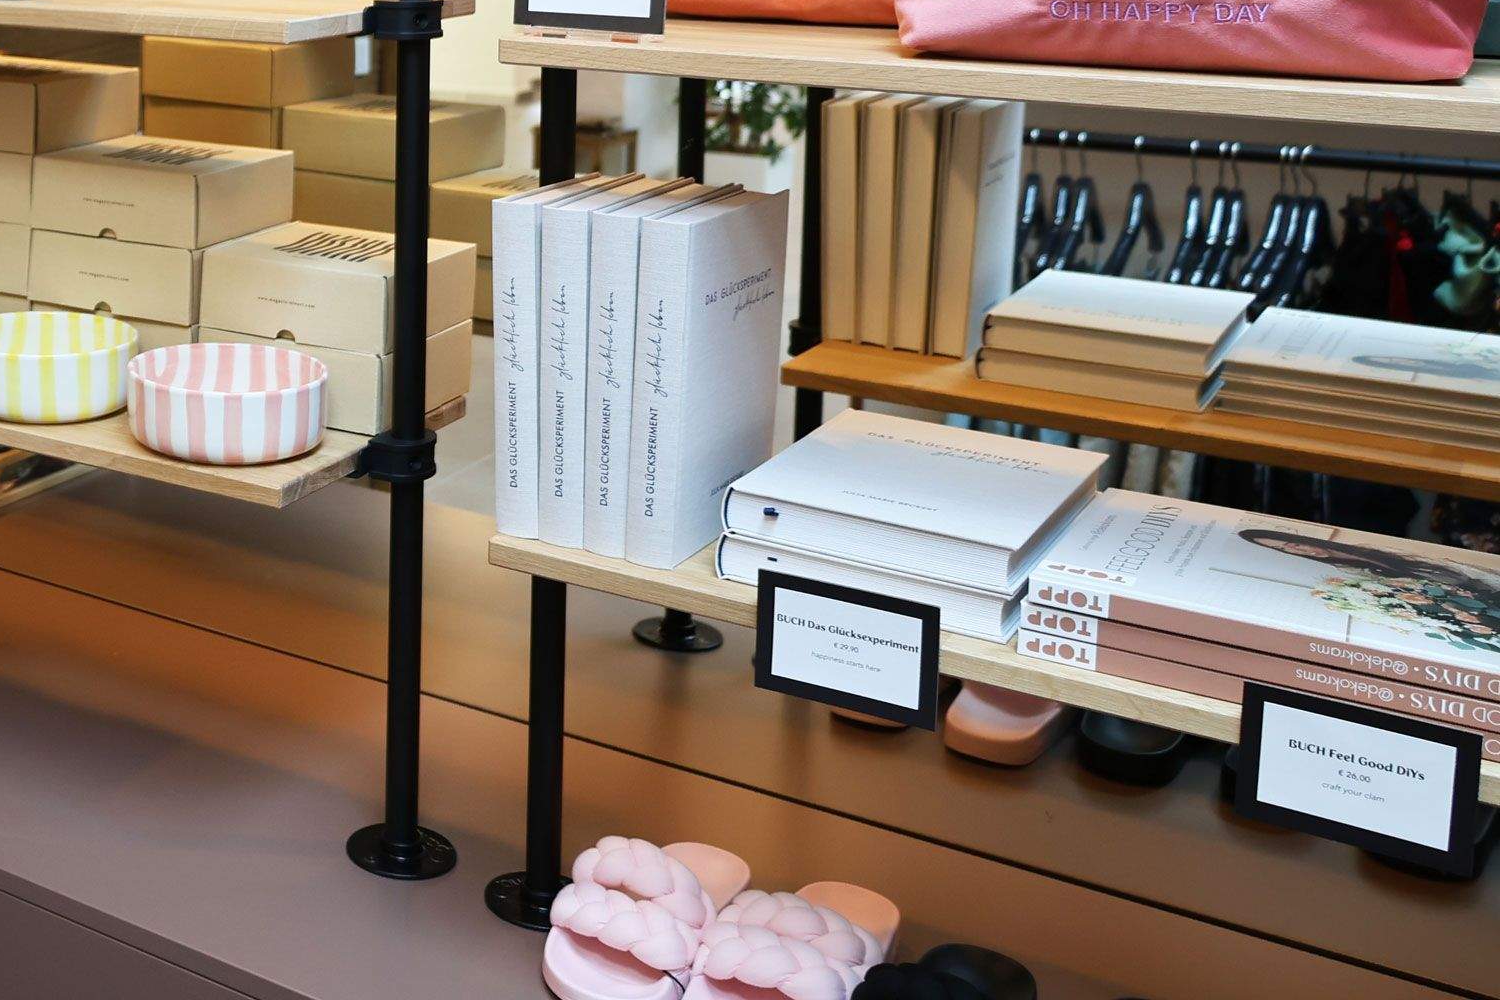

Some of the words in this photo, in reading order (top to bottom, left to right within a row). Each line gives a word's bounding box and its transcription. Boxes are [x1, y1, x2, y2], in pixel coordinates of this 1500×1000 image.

[1051, 0, 1091, 20] OH
[1101, 1, 1200, 24] HAPPY
[1214, 2, 1270, 24] DAY
[705, 291, 718, 306] DAS
[508, 381, 518, 466] GLÜCKSPERIMENT
[553, 390, 564, 476] GLÜCKSPERIMENT
[868, 432, 894, 440] DAS
[600, 397, 611, 485] GLÜCKSPERIMENT
[645, 406, 658, 494] GLÜCKSPERIMENT
[509, 469, 518, 488] DAS
[555, 477, 564, 498] DAS
[600, 487, 609, 507] DAS
[645, 497, 654, 517] DAS
[1047, 564, 1126, 584] TOPP
[1038, 586, 1103, 612] TOPP
[777, 613, 806, 627] BUCH
[807, 620, 826, 632] Das
[828, 625, 920, 654] Glücksexperiment
[1027, 611, 1091, 637] TOPP
[811, 650, 844, 665] happiness
[845, 659, 864, 670] starts
[865, 664, 882, 673] here
[1026, 638, 1090, 664] TOPP
[1309, 642, 1409, 676] @dekokrams
[1295, 668, 1395, 702] @dekokrams
[1425, 665, 1481, 692] DIYS
[1410, 692, 1465, 719] DIYS
[1288, 738, 1326, 756] BUCH
[1329, 748, 1355, 763] Feel
[1358, 756, 1393, 773] Good
[1321, 781, 1341, 792] craft
[1342, 787, 1362, 798] your
[1345, 771, 1372, 783] 26,00
